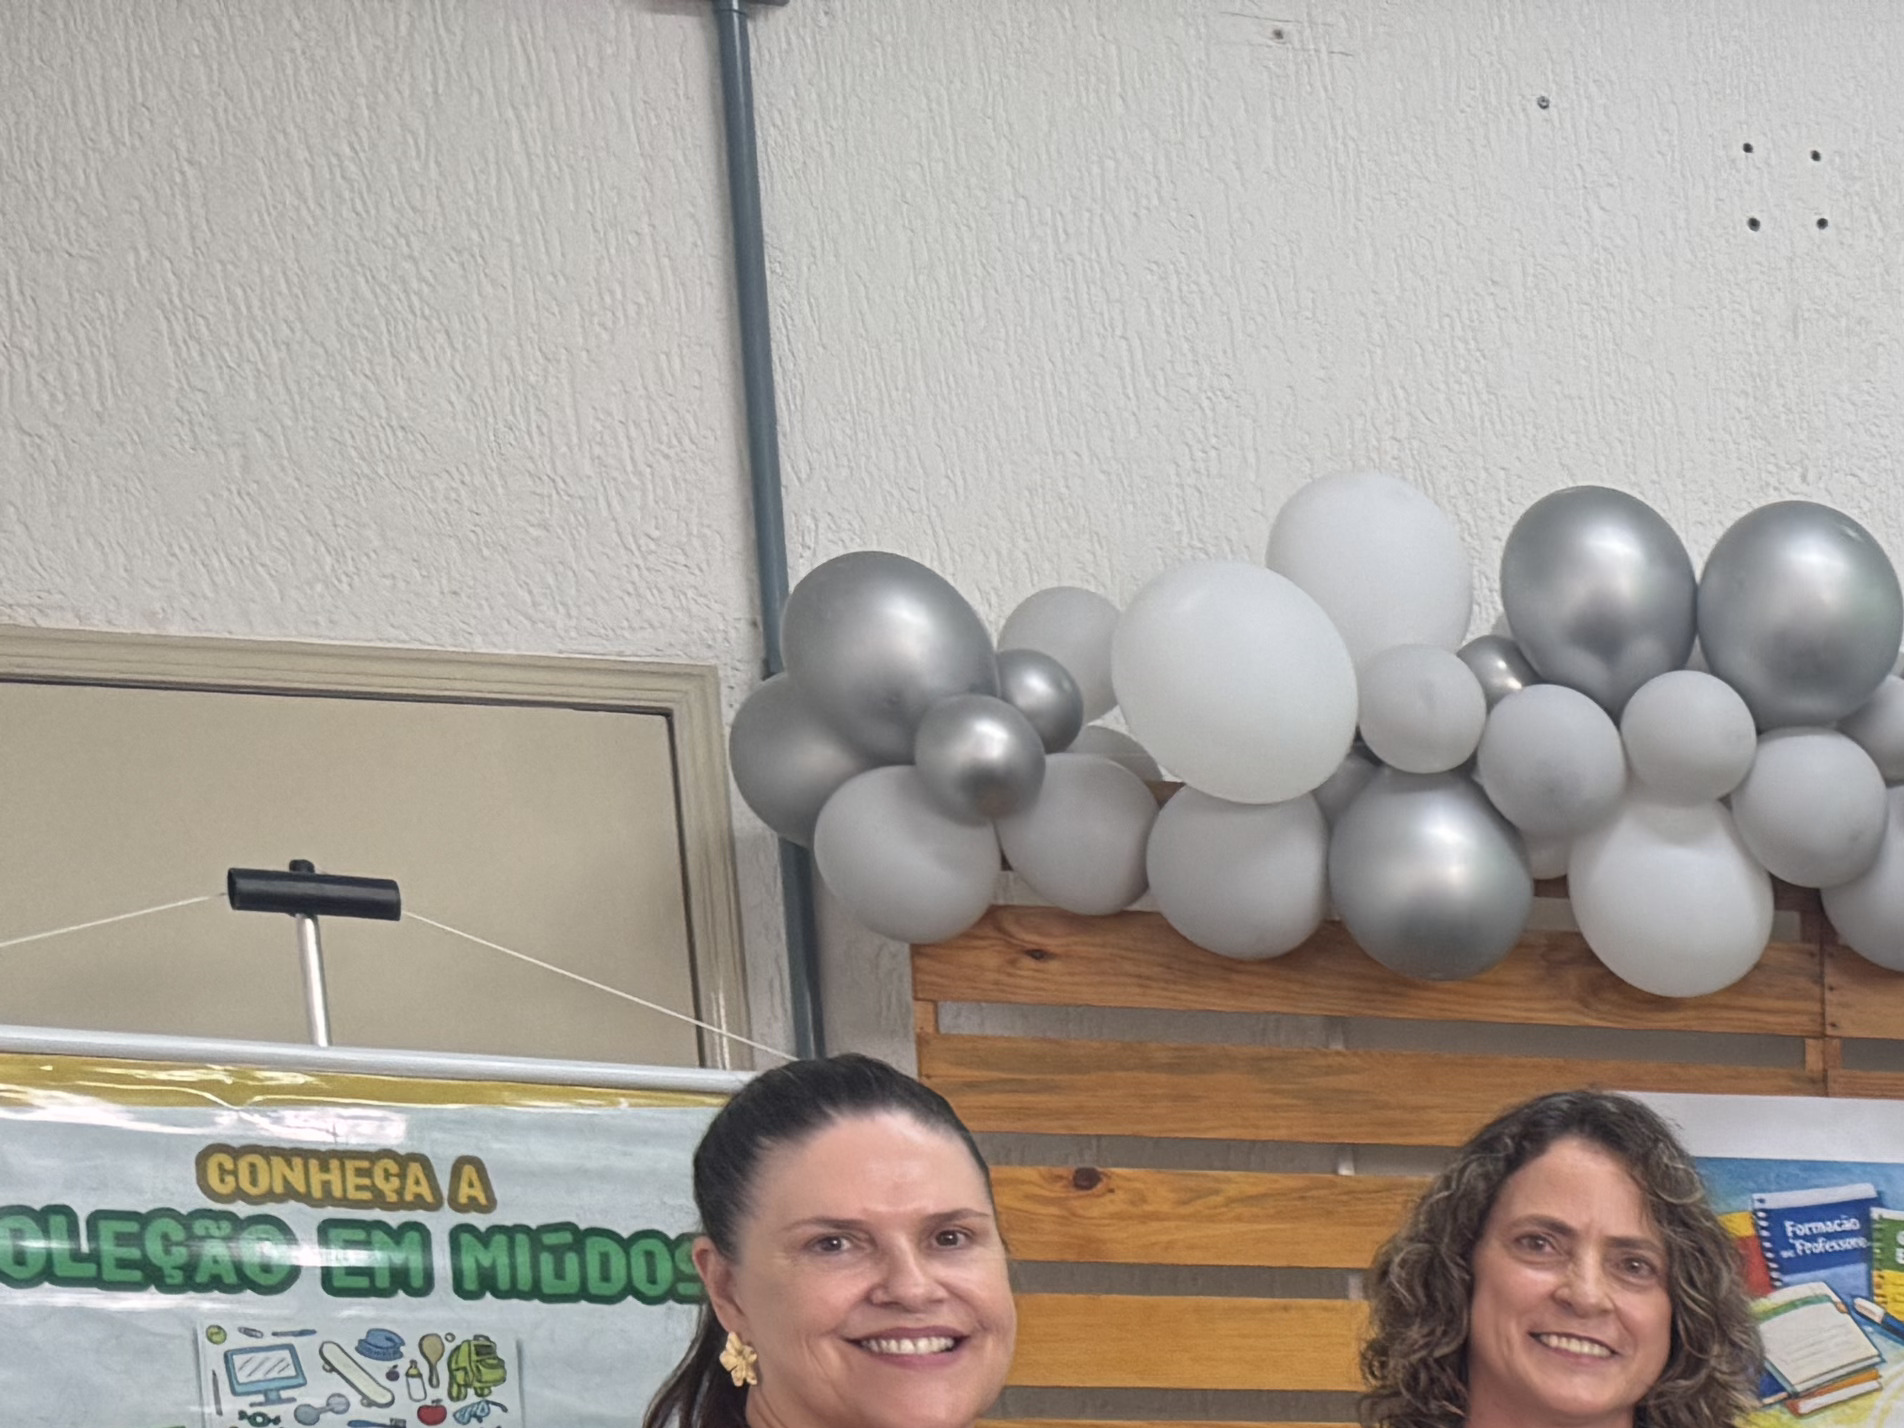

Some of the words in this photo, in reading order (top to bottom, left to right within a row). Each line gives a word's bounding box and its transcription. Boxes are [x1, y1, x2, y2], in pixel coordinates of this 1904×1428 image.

[203, 1150, 437, 1205] CONHEÇA
[454, 1162, 492, 1208] A
[0, 1211, 294, 1288] OLEÇÃO
[326, 1225, 426, 1291] EM
